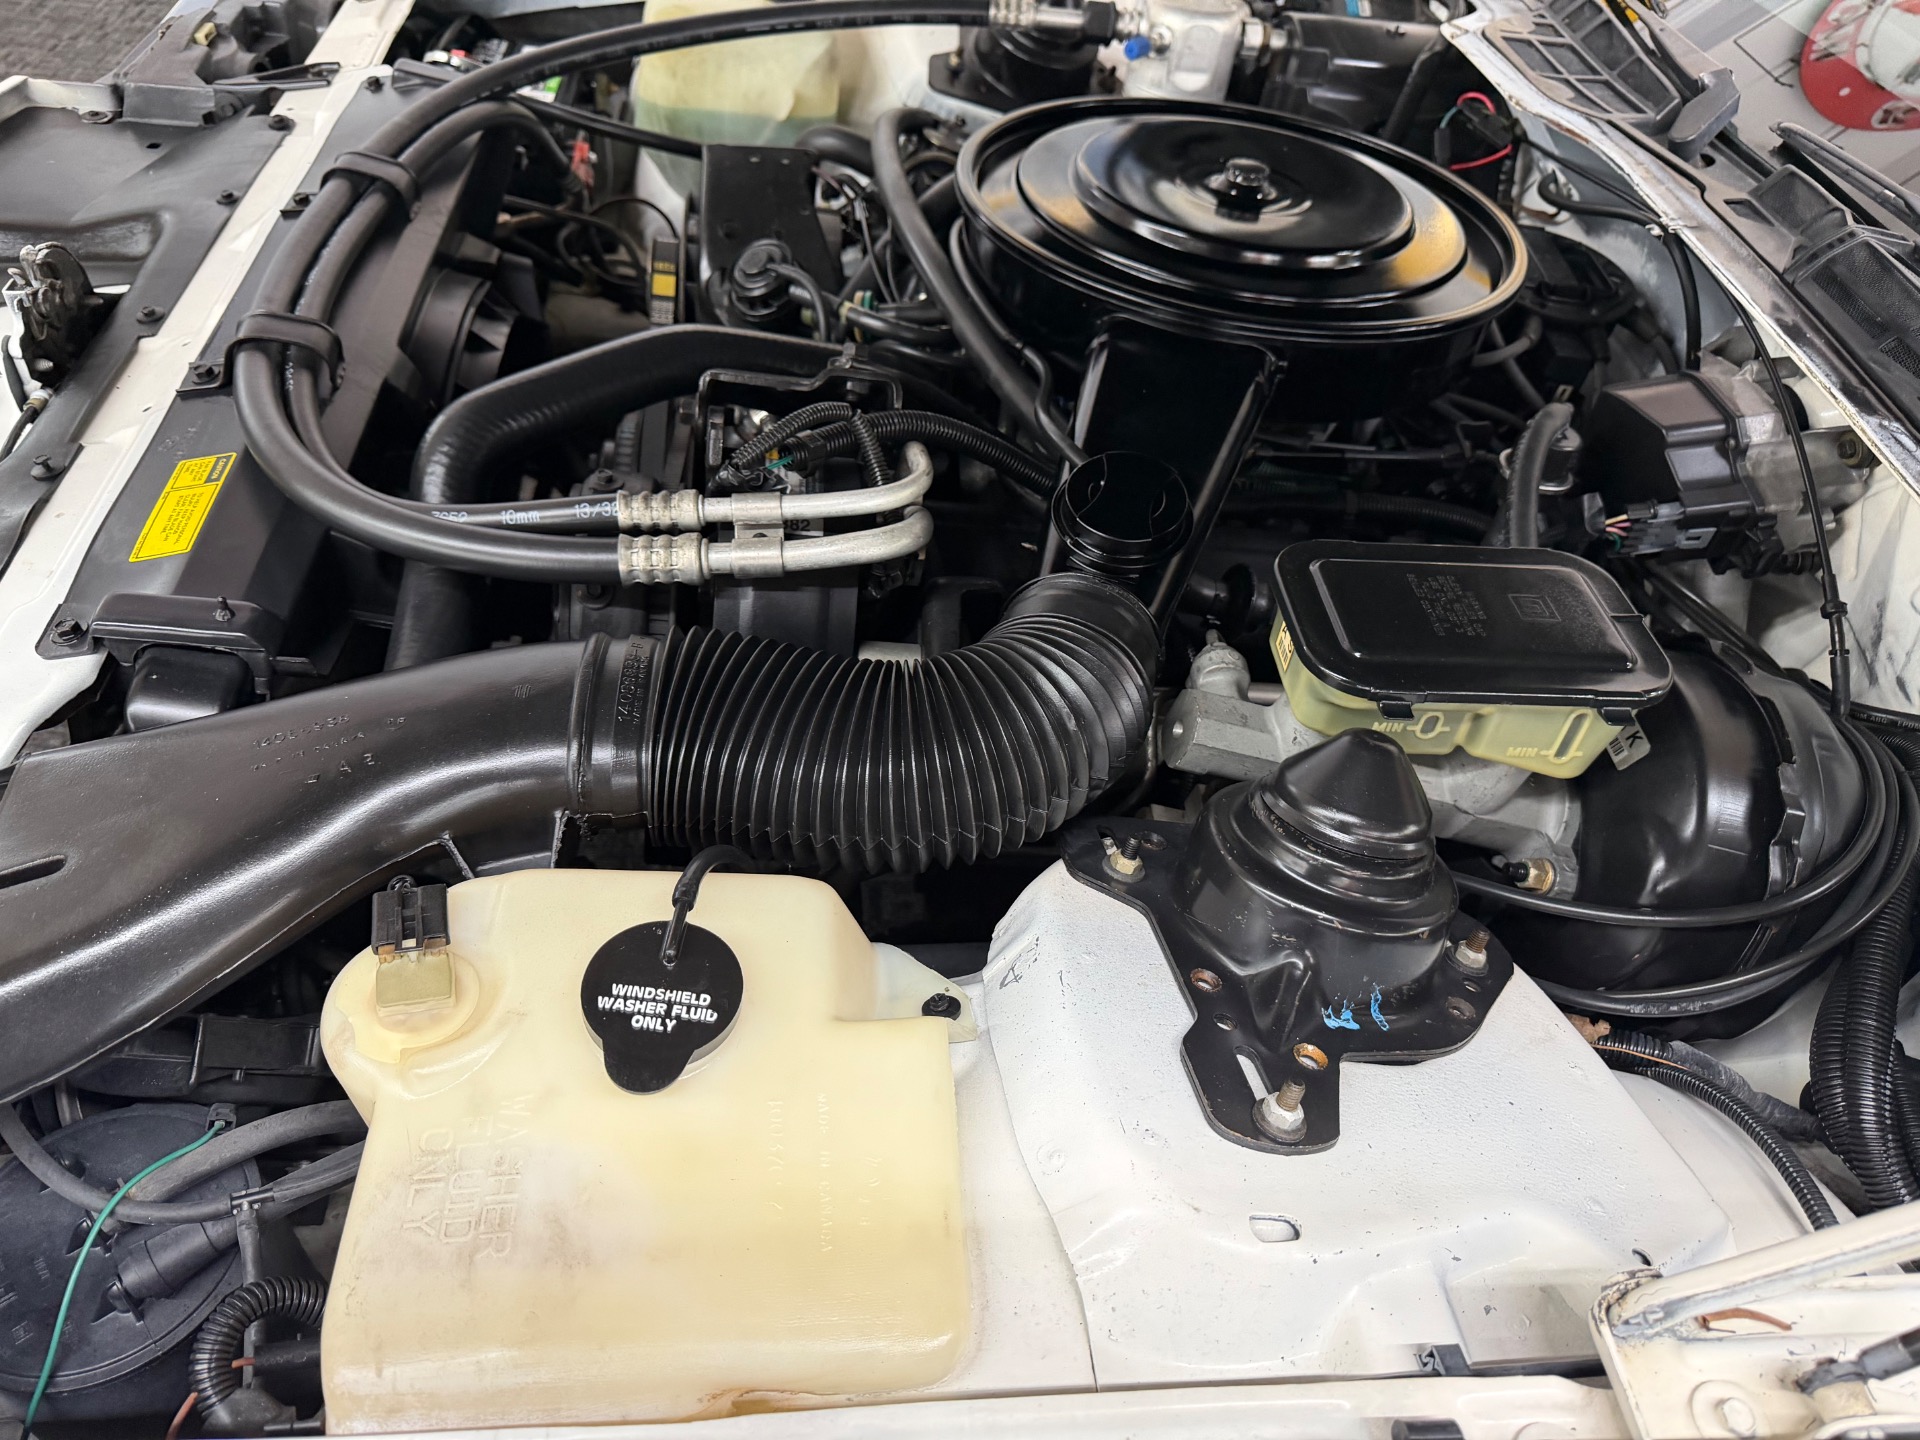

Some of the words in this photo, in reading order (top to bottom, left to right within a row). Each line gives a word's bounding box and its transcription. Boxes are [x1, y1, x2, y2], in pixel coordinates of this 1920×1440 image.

[211, 457, 227, 479] CAUTION
[501, 509, 540, 525] 10mm
[1372, 721, 1405, 733] MIN
[1506, 747, 1538, 758] MIN
[611, 983, 711, 1007] WINDSHIELD
[597, 996, 667, 1016] WASHER
[671, 1005, 718, 1023] FLUID
[631, 1014, 677, 1033] ONLY
[402, 1128, 454, 1237] ONLY
[439, 1114, 493, 1244] FLUID
[477, 1092, 535, 1259] WASHER
